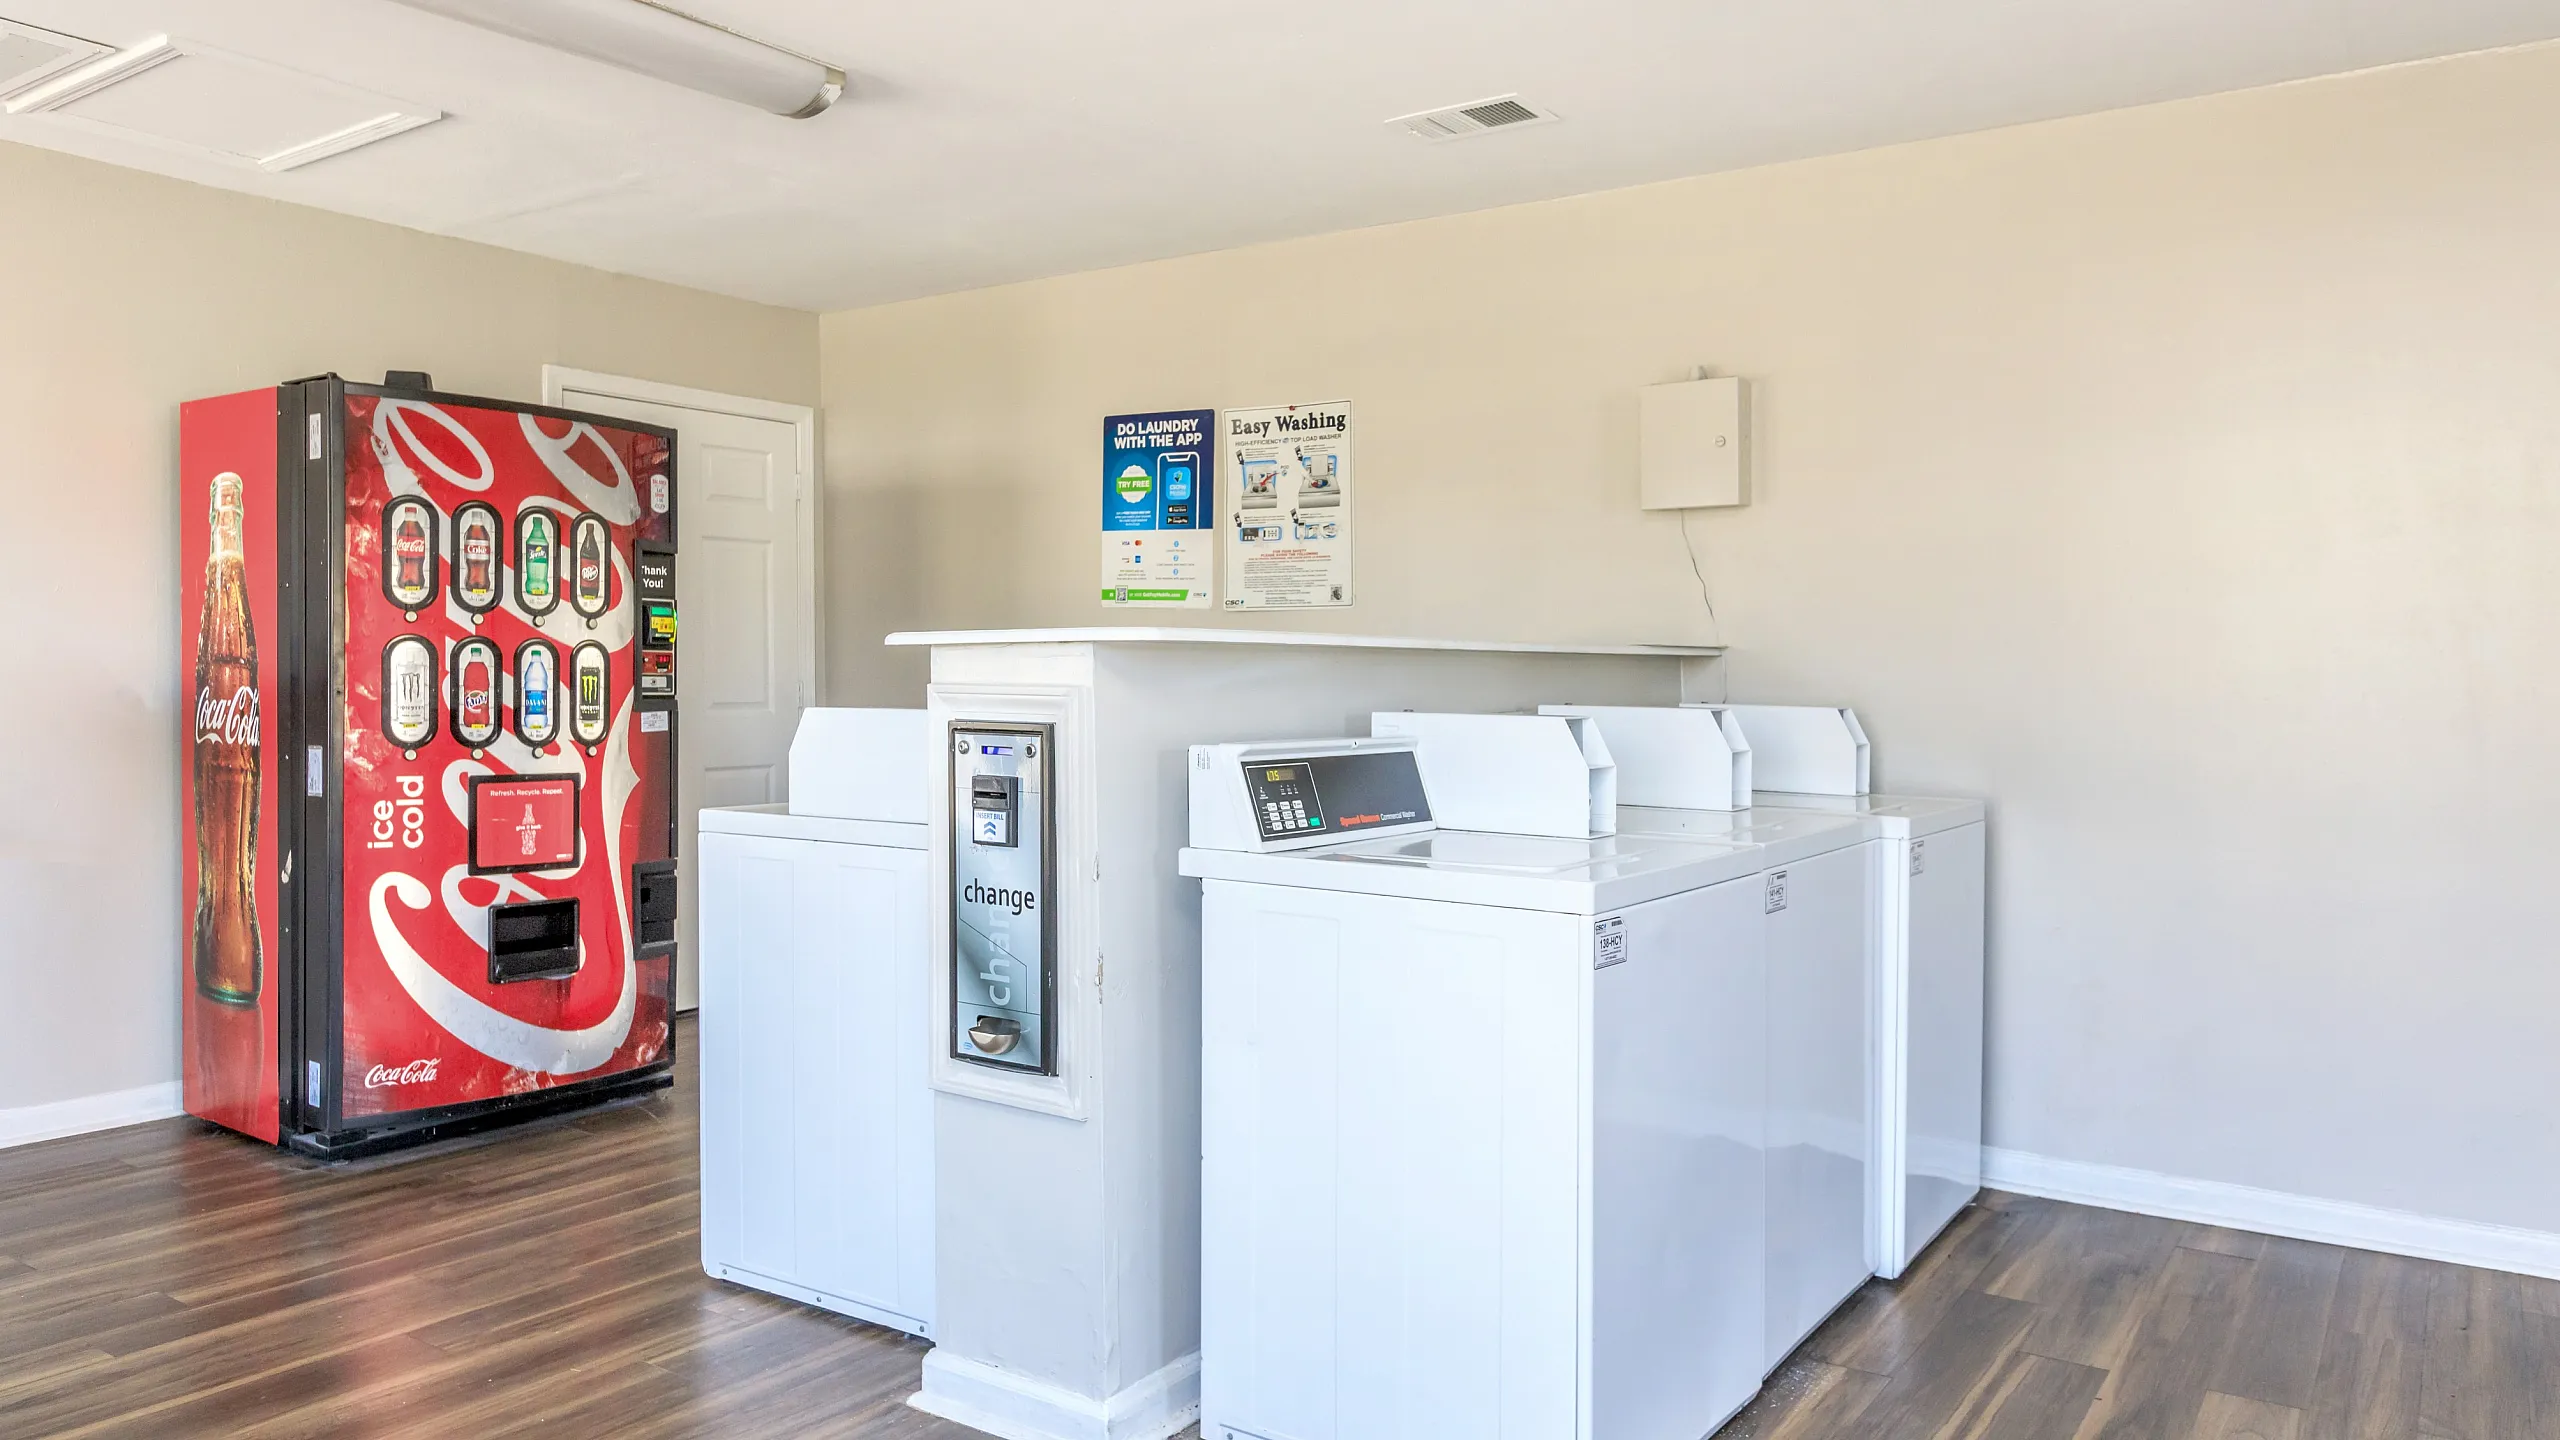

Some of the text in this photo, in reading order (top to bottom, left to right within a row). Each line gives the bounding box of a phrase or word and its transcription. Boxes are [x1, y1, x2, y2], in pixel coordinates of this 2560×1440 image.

[1117, 419, 1199, 436] DO LAUNDRY
[1231, 412, 1346, 438] Easy Washing
[1114, 433, 1203, 449] WITH THE APP
[1132, 480, 1150, 488] FREE
[397, 539, 424, 553] Coca-Cola
[467, 545, 487, 554] Coke
[642, 578, 664, 588] You!
[195, 685, 260, 747] Coca-Cola
[396, 775, 424, 849] cold
[976, 812, 1004, 821] INSERT BILL
[367, 800, 394, 849] ice
[964, 877, 1035, 915] change
[1600, 935, 1622, 949] 138-HCY
[364, 1057, 442, 1089] Coca-Cola
